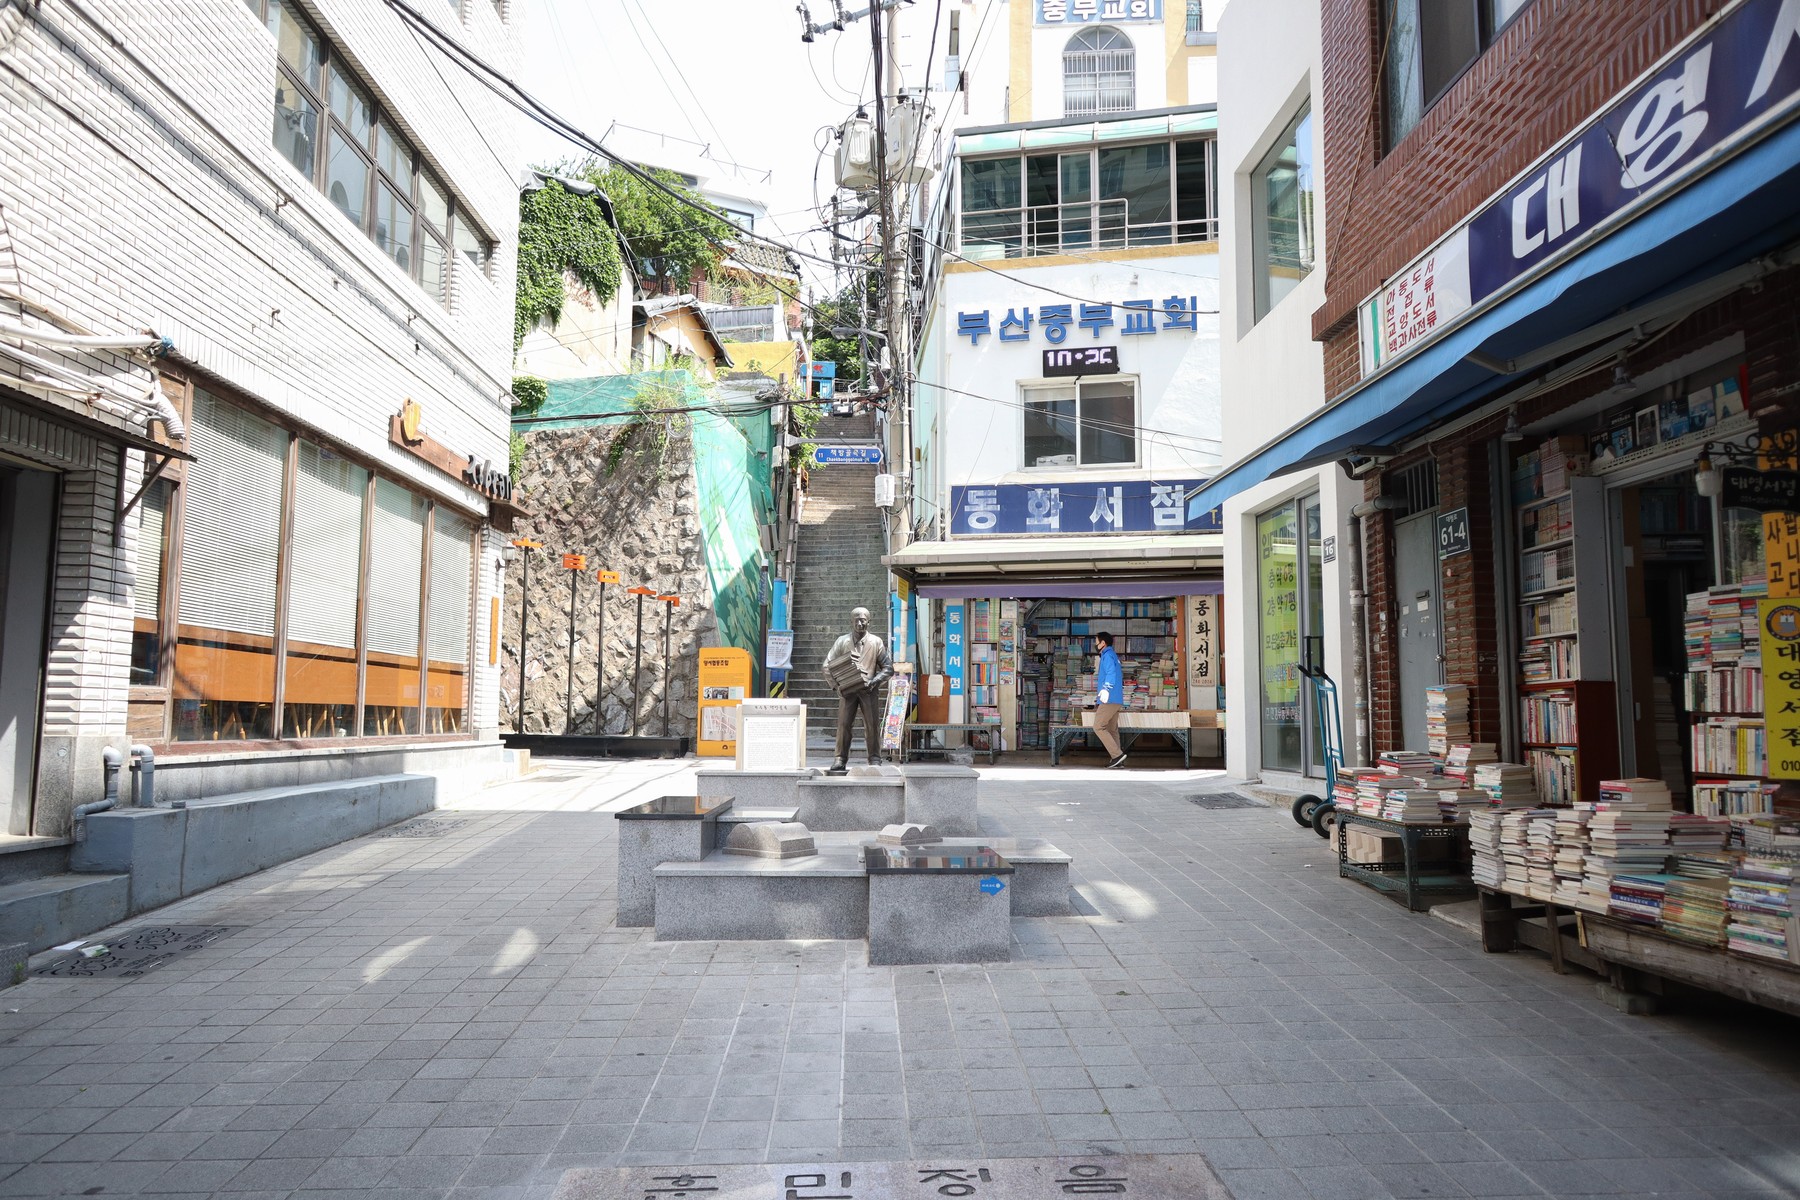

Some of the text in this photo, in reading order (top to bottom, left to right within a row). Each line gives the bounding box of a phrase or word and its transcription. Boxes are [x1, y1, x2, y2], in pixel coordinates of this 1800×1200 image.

[1042, 0, 1155, 21] 중부교회
[1386, 258, 1434, 305] 아동도서
[1387, 275, 1433, 323] 전집류
[957, 295, 1198, 345] 부산중부교회
[1388, 292, 1435, 337] 교양도서
[1389, 310, 1437, 353] 백과사전류
[964, 485, 1185, 528] 동화서점
[1731, 476, 1797, 497] 대영서점
[1324, 545, 1334, 556] 16
[1441, 521, 1466, 546] 61-4
[948, 611, 961, 690] 동화서점
[1195, 599, 1211, 677] 동화서점
